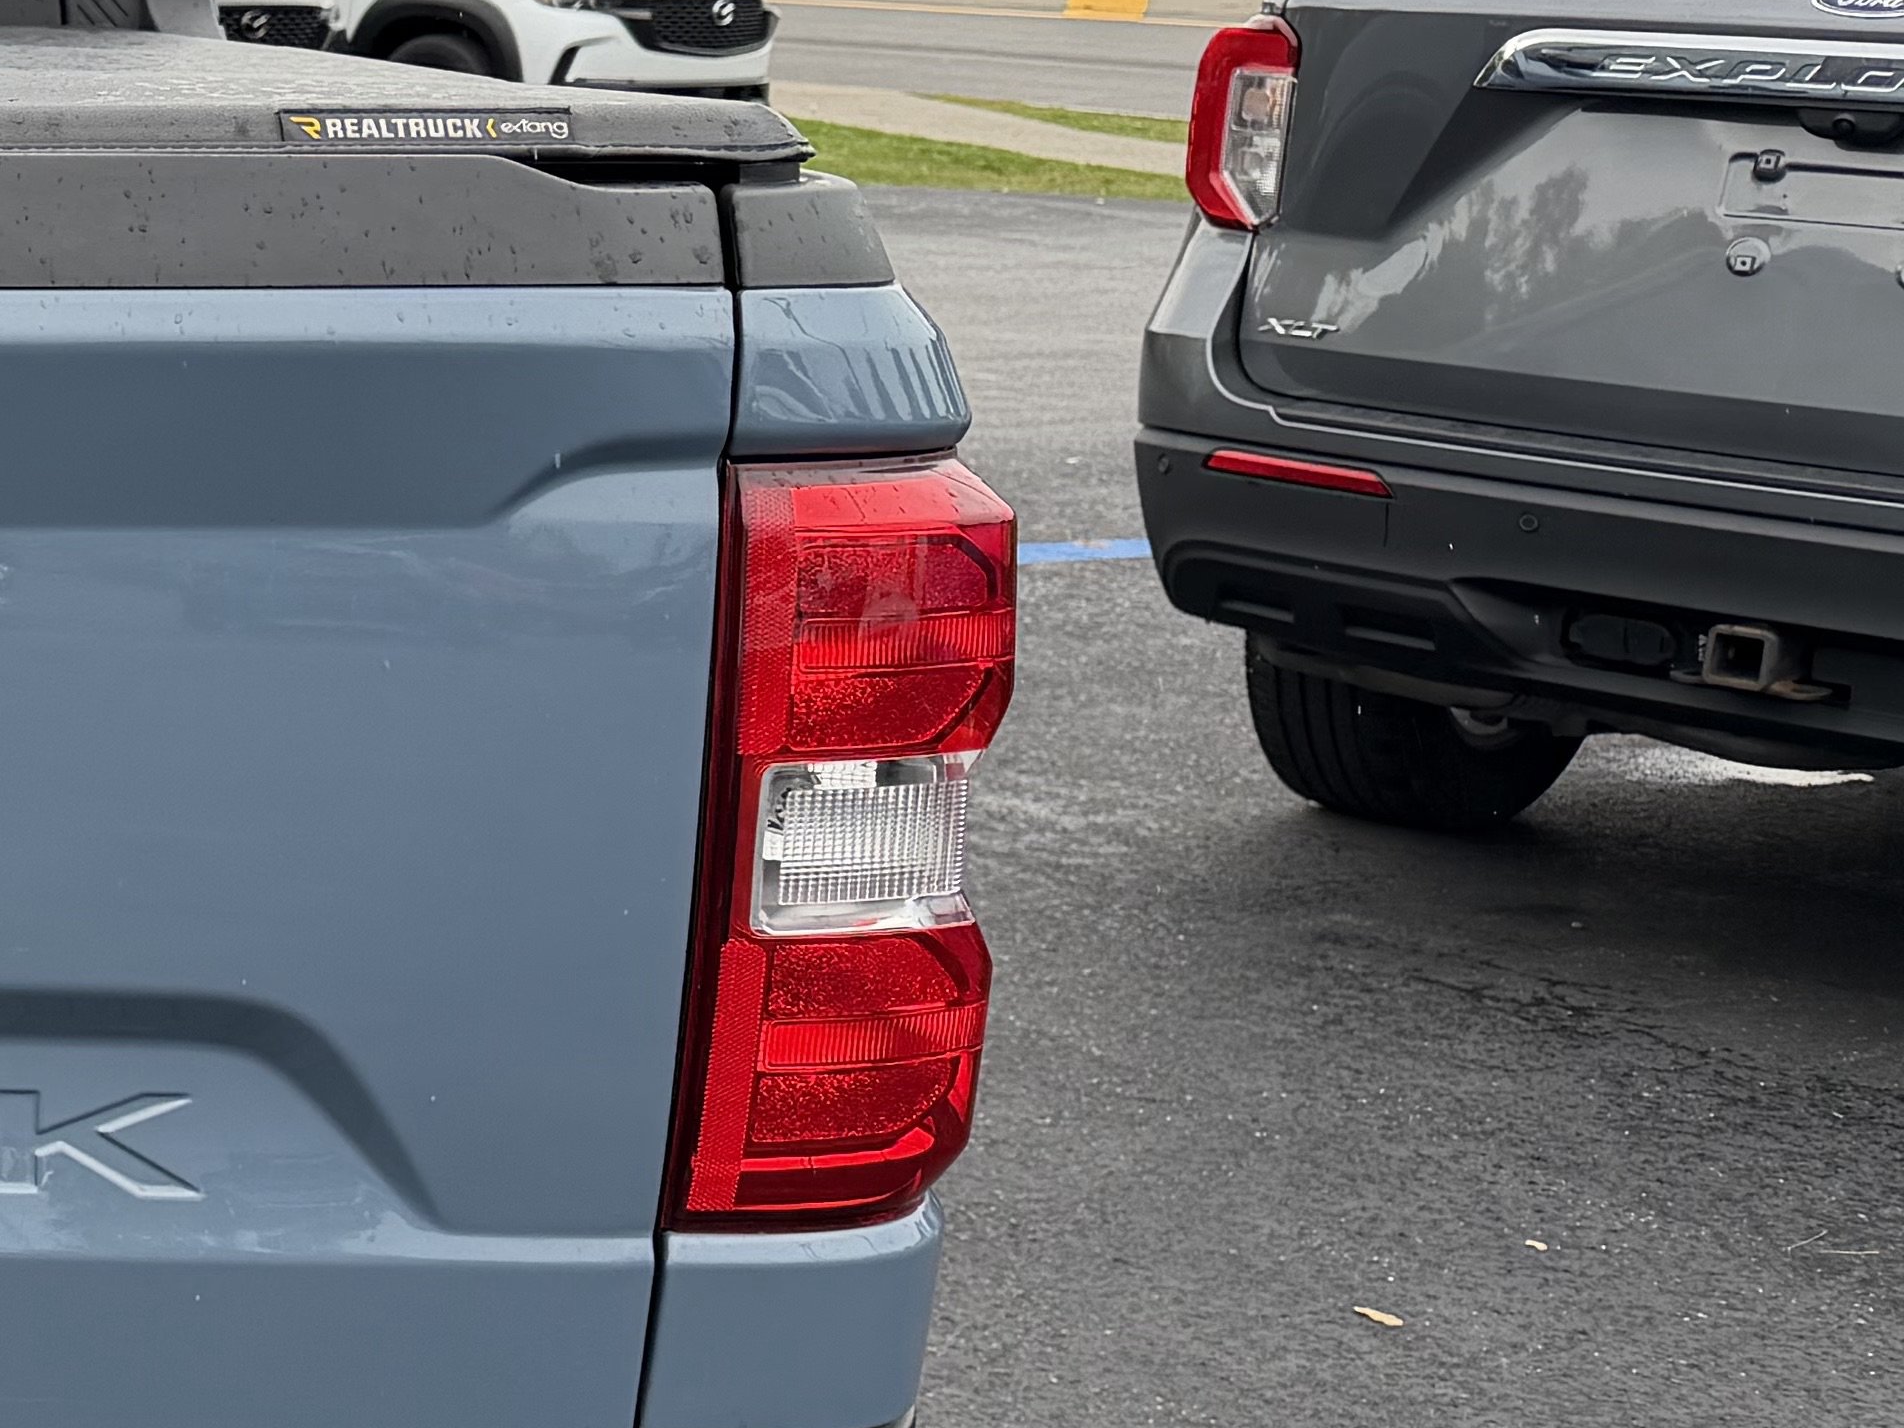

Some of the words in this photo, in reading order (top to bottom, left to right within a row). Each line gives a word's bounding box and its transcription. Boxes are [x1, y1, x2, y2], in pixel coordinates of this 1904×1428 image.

[327, 117, 484, 139] REALTRUCK
[500, 119, 570, 140] extang
[1257, 317, 1338, 339] XLT
